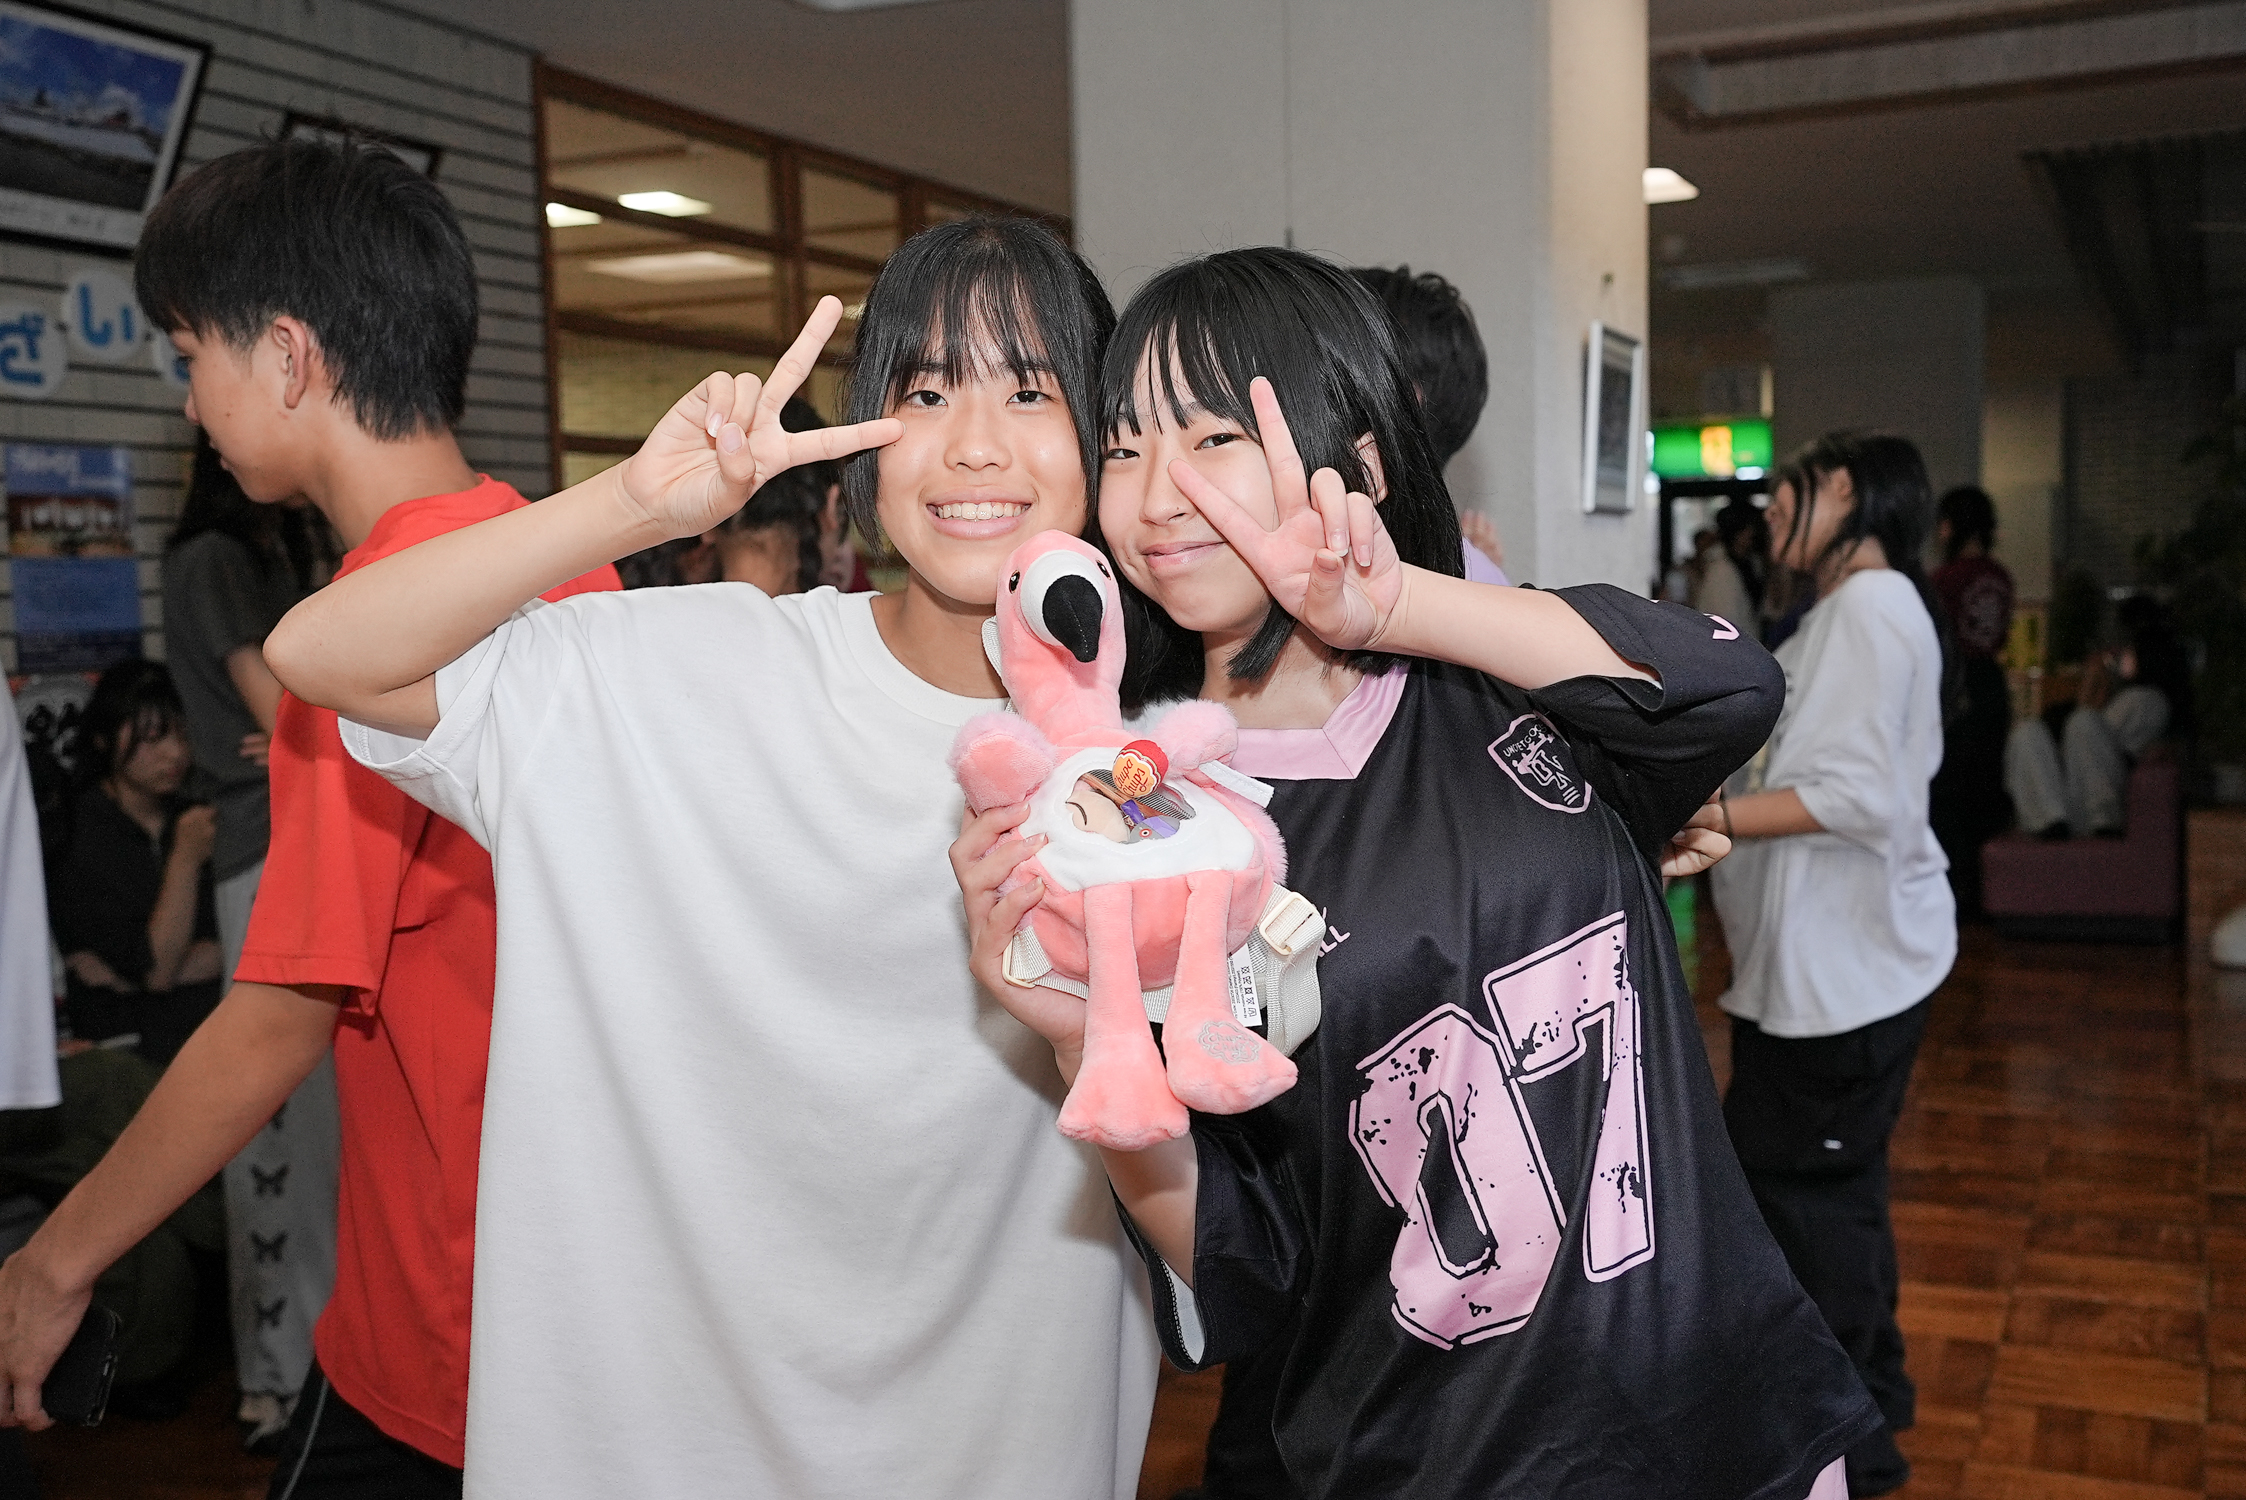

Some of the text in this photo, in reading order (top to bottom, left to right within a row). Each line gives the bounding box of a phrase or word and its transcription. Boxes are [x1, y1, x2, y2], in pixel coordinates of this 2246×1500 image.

[1114, 758, 1134, 789] Chupa
[1122, 767, 1149, 797] Chups
[1348, 910, 1656, 1350] 07
